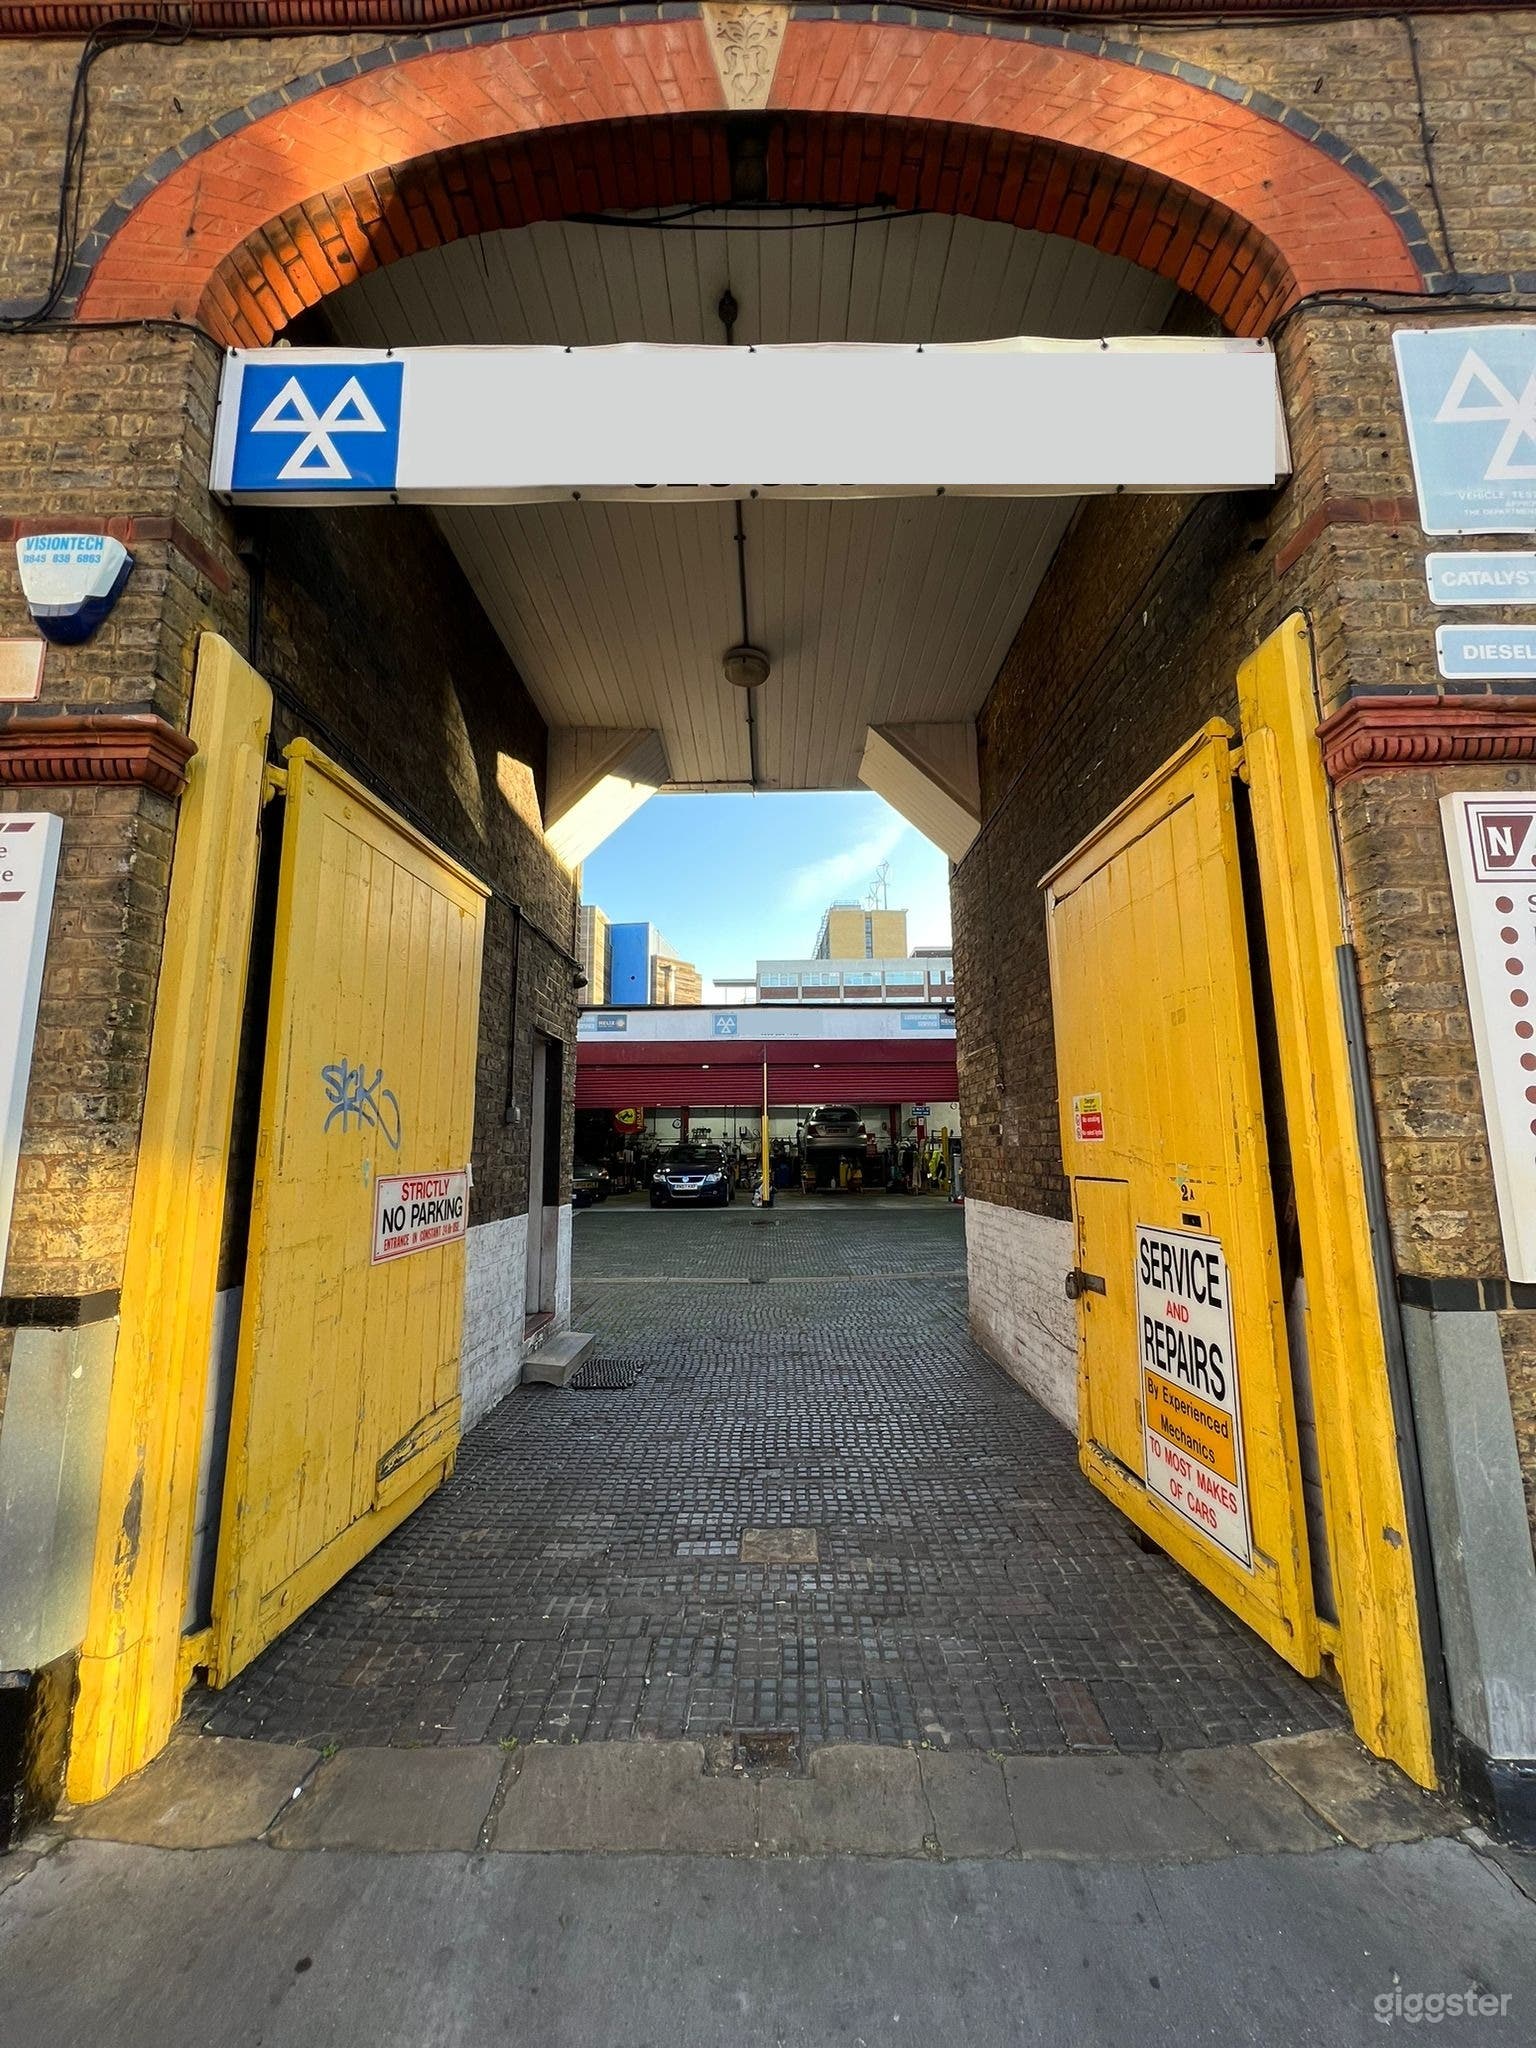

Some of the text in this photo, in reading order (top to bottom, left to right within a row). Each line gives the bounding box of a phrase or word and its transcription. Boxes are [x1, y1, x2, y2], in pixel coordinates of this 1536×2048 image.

[26, 537, 104, 551] VISIONTECH
[1463, 644, 1536, 660] DIESEL
[401, 1178, 450, 1201] STRICTLY
[382, 1196, 463, 1235] NO PARKING
[383, 1233, 410, 1251] ENTRANCE
[419, 1225, 442, 1242] CONSTANT
[1140, 1237, 1222, 1309] SERVICE
[1166, 1301, 1189, 1324] AND
[1143, 1315, 1226, 1401] REPAIRS
[1147, 1377, 1229, 1439] By Experienced
[1161, 1414, 1215, 1464] Mechanics
[1150, 1435, 1238, 1514] TO MOST MAKES
[1169, 1478, 1217, 1530] OF CARS
